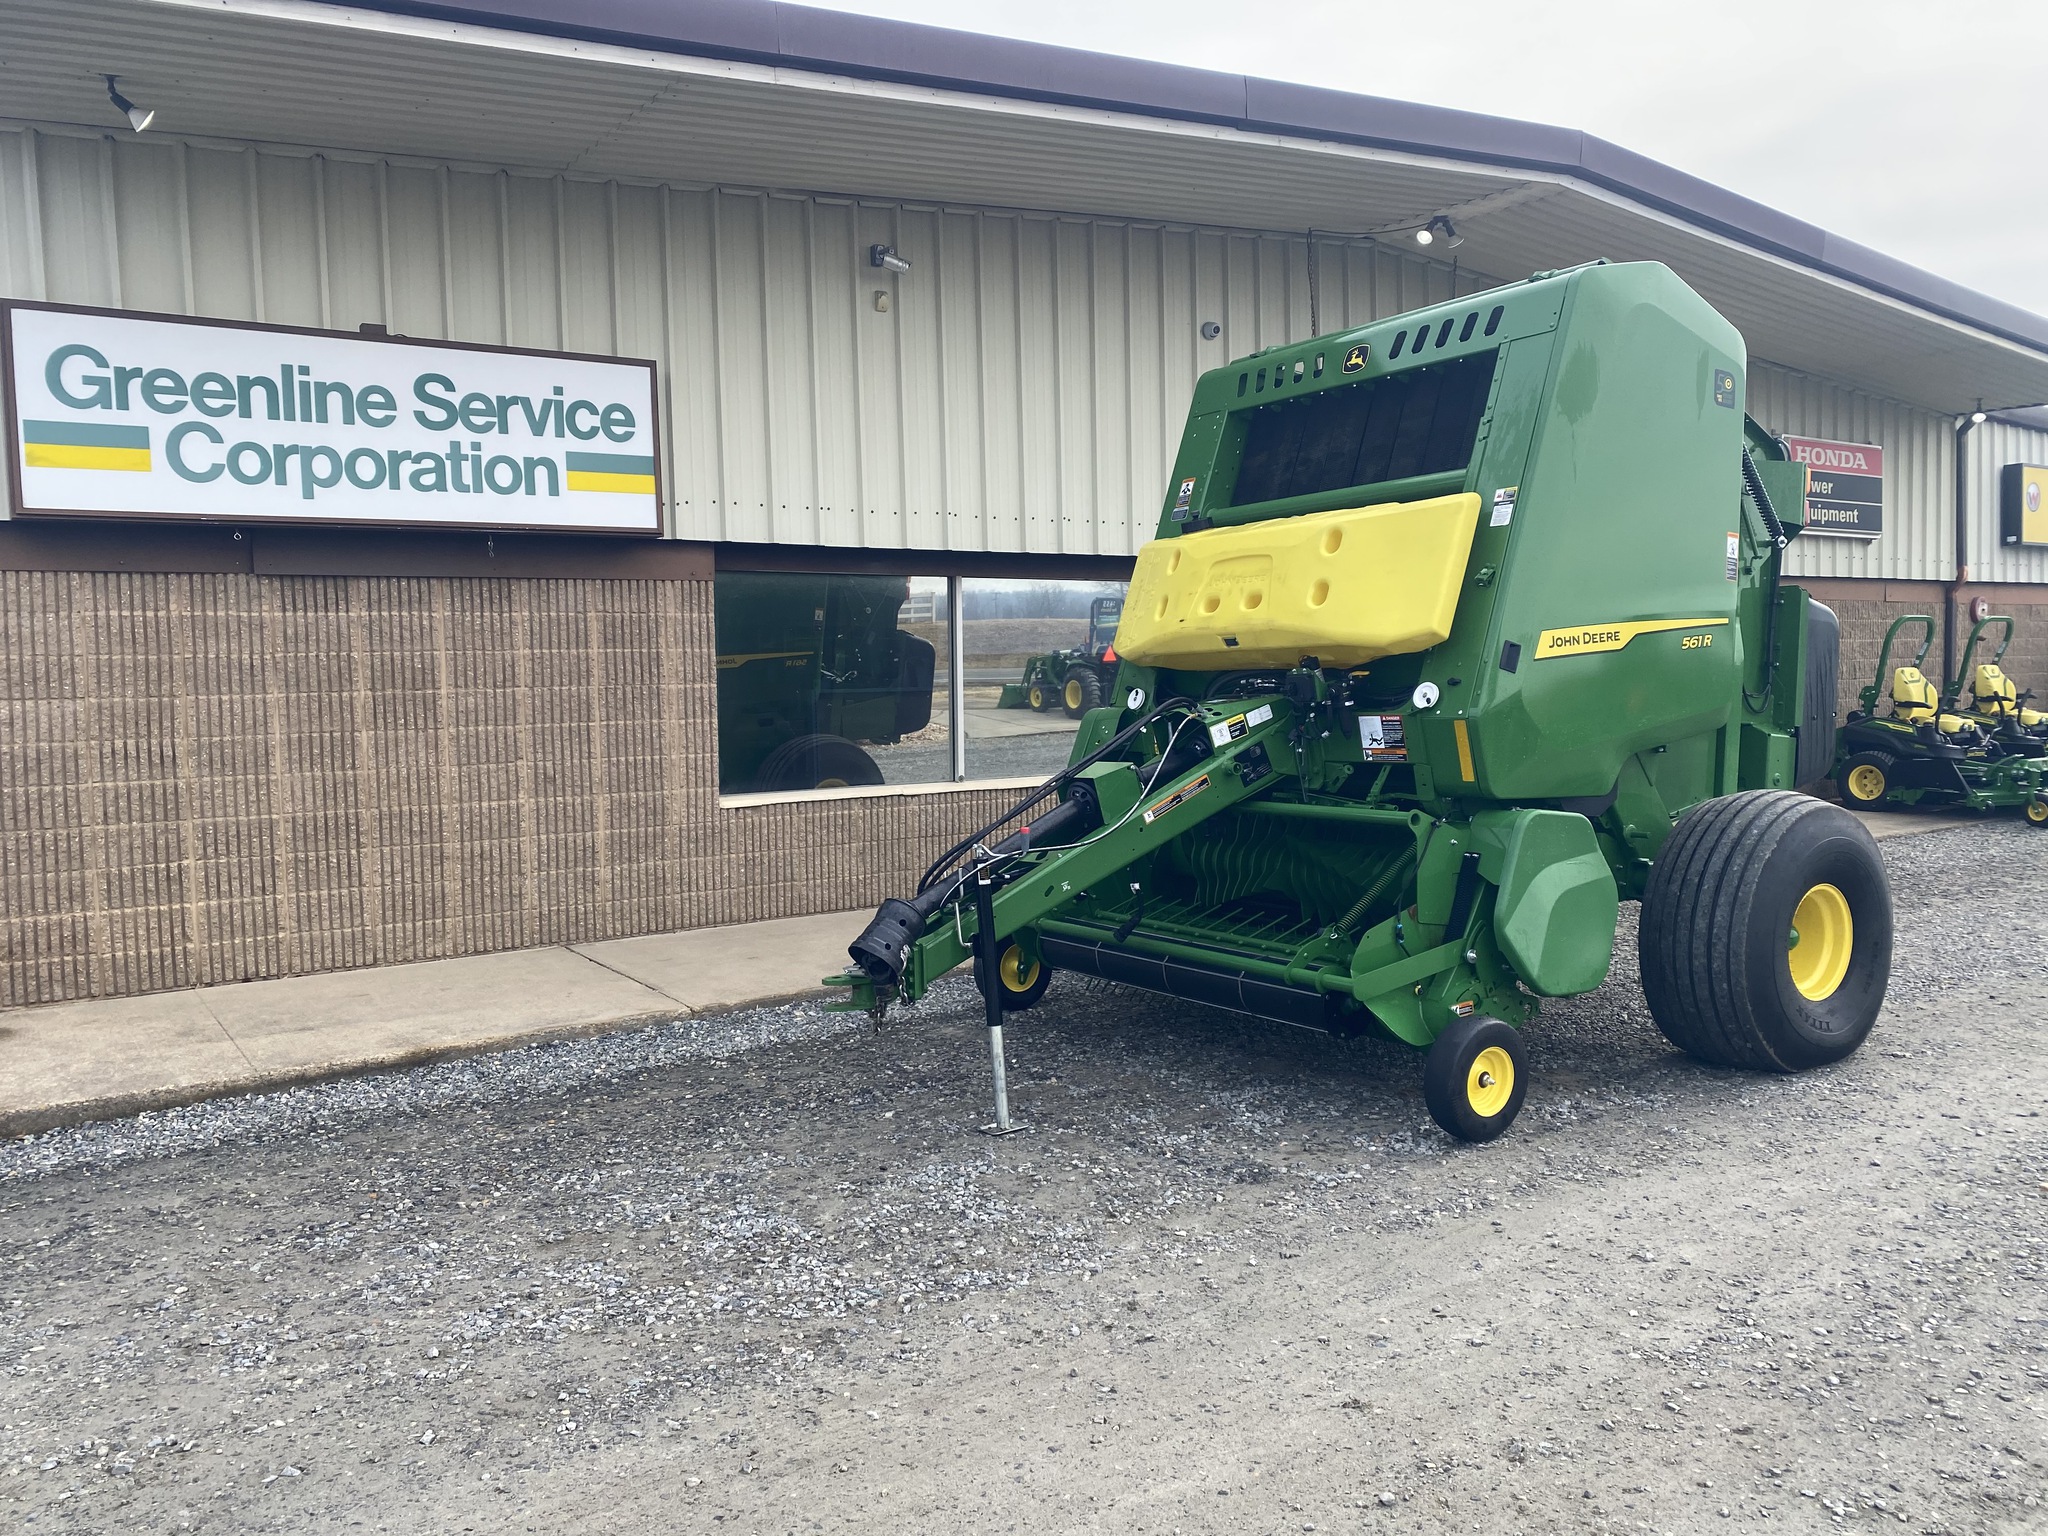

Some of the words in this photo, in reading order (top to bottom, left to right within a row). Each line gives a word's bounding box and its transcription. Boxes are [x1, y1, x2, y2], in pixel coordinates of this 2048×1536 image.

[45, 343, 397, 428] Greenline
[413, 373, 636, 443] Service
[165, 421, 560, 499] Corporation
[1795, 445, 1868, 470] HONDA
[1810, 480, 1833, 495] wer
[1808, 503, 1859, 525] uipment
[1548, 635, 1580, 649] JOHN
[1582, 631, 1621, 645] DEERE
